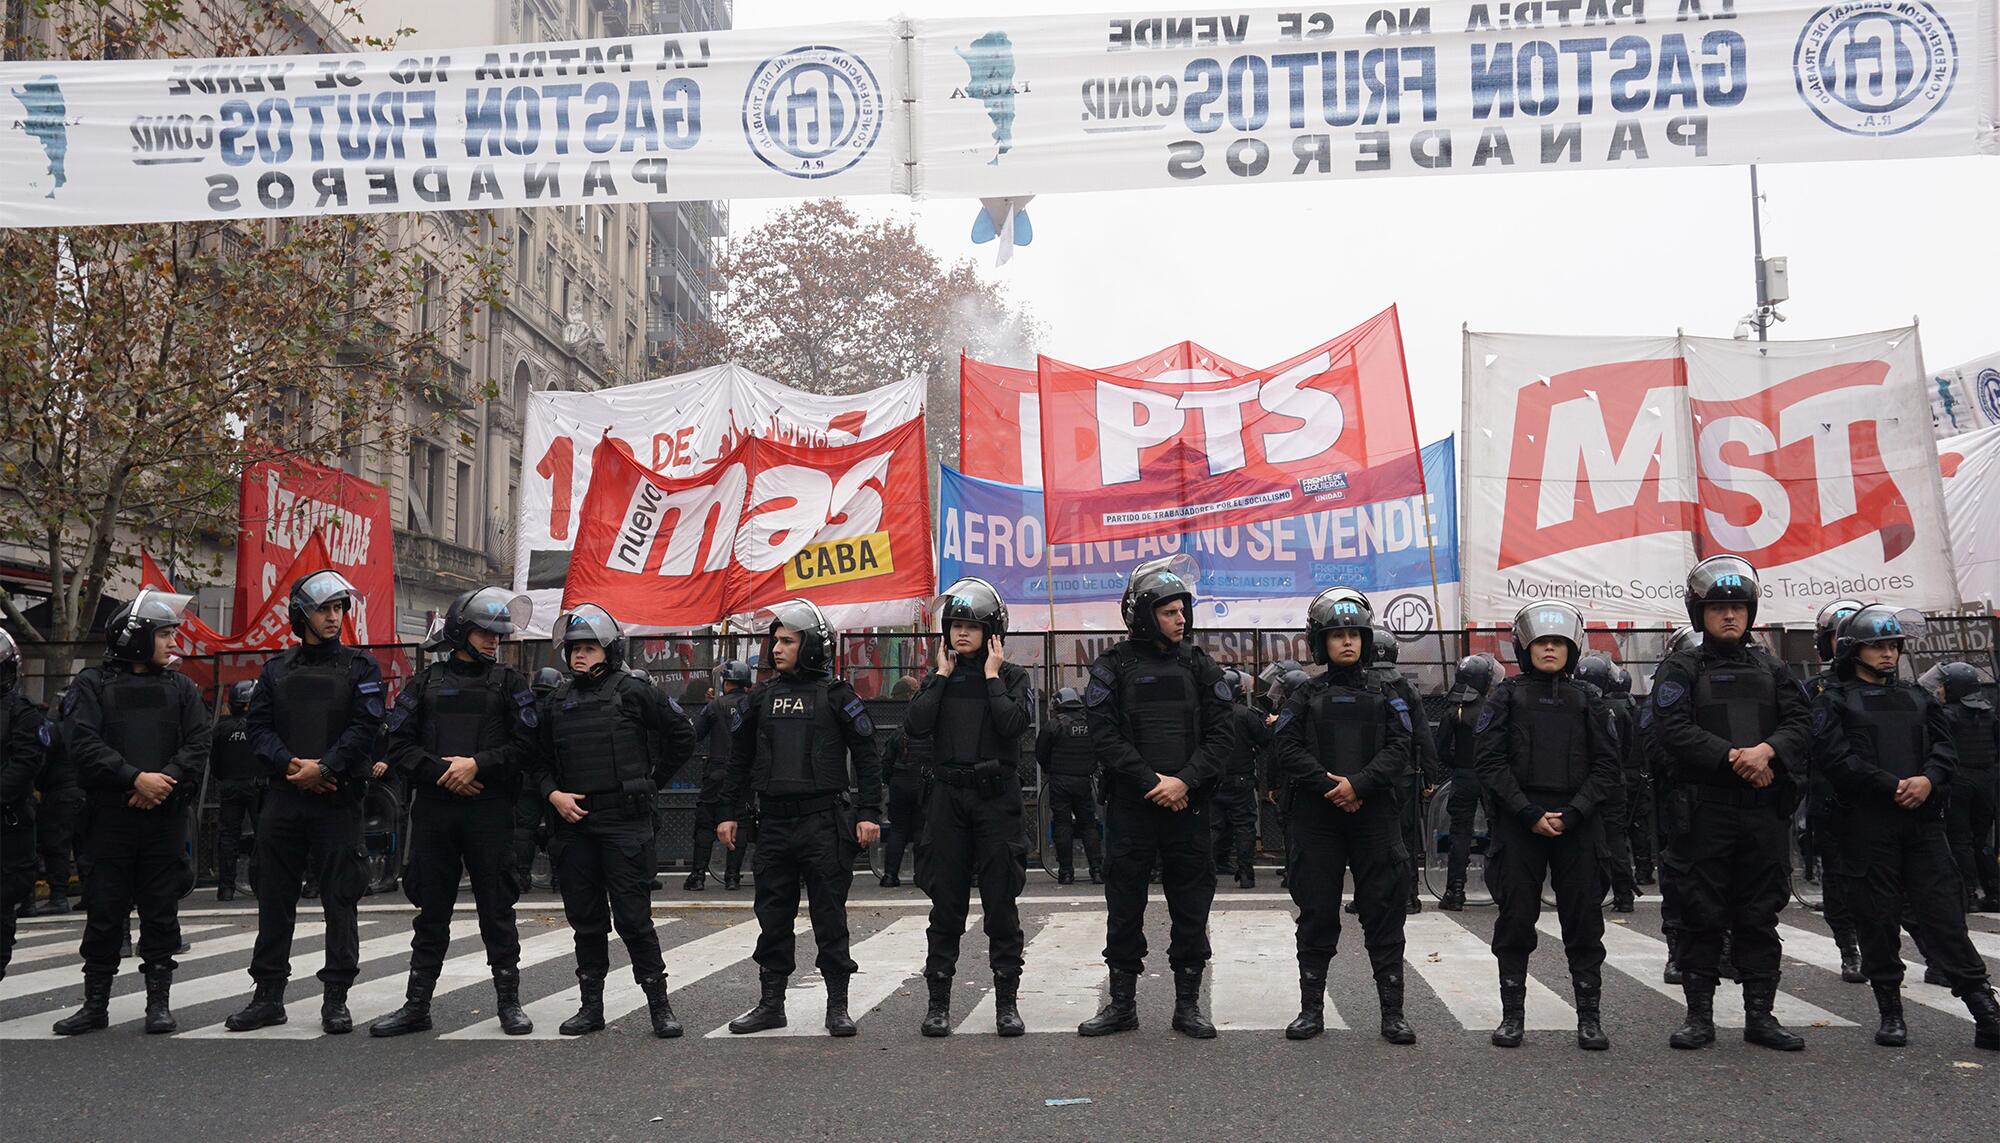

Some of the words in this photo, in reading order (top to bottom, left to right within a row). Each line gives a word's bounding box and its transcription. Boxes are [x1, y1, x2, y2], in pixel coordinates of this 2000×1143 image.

[1094, 351, 1345, 486] PTS
[652, 426, 695, 473] DE
[1302, 473, 1333, 487] FRENTE
[1537, 384, 1886, 552] MST
[1303, 479, 1346, 493] IZQUIERDA
[1314, 491, 1344, 503] UNIDAD
[1106, 513, 1140, 523] PARTIDO
[1141, 512, 1152, 520] DE
[1154, 505, 1215, 519] TRABAJADORES
[1233, 498, 1243, 506] EL
[1244, 492, 1291, 506] SOCIALISMO
[618, 482, 664, 568] nuevo
[1194, 508, 1240, 558] NO
[1246, 508, 1297, 562] SE
[1303, 494, 1438, 562] VENDE
[794, 538, 879, 581] CABA
[1029, 579, 1081, 592] PARTIDO
[1084, 579, 1098, 591] DE
[1100, 578, 1124, 590] LOS
[1217, 575, 1293, 588] SOCIALISTAS
[1507, 578, 1624, 599] Movimiento
[1779, 574, 1914, 600] Trabajadores
[1334, 602, 1359, 616] PFA
[1389, 601, 1427, 632] GPS
[1538, 611, 1564, 625] PFA
[772, 697, 804, 714] PFA
